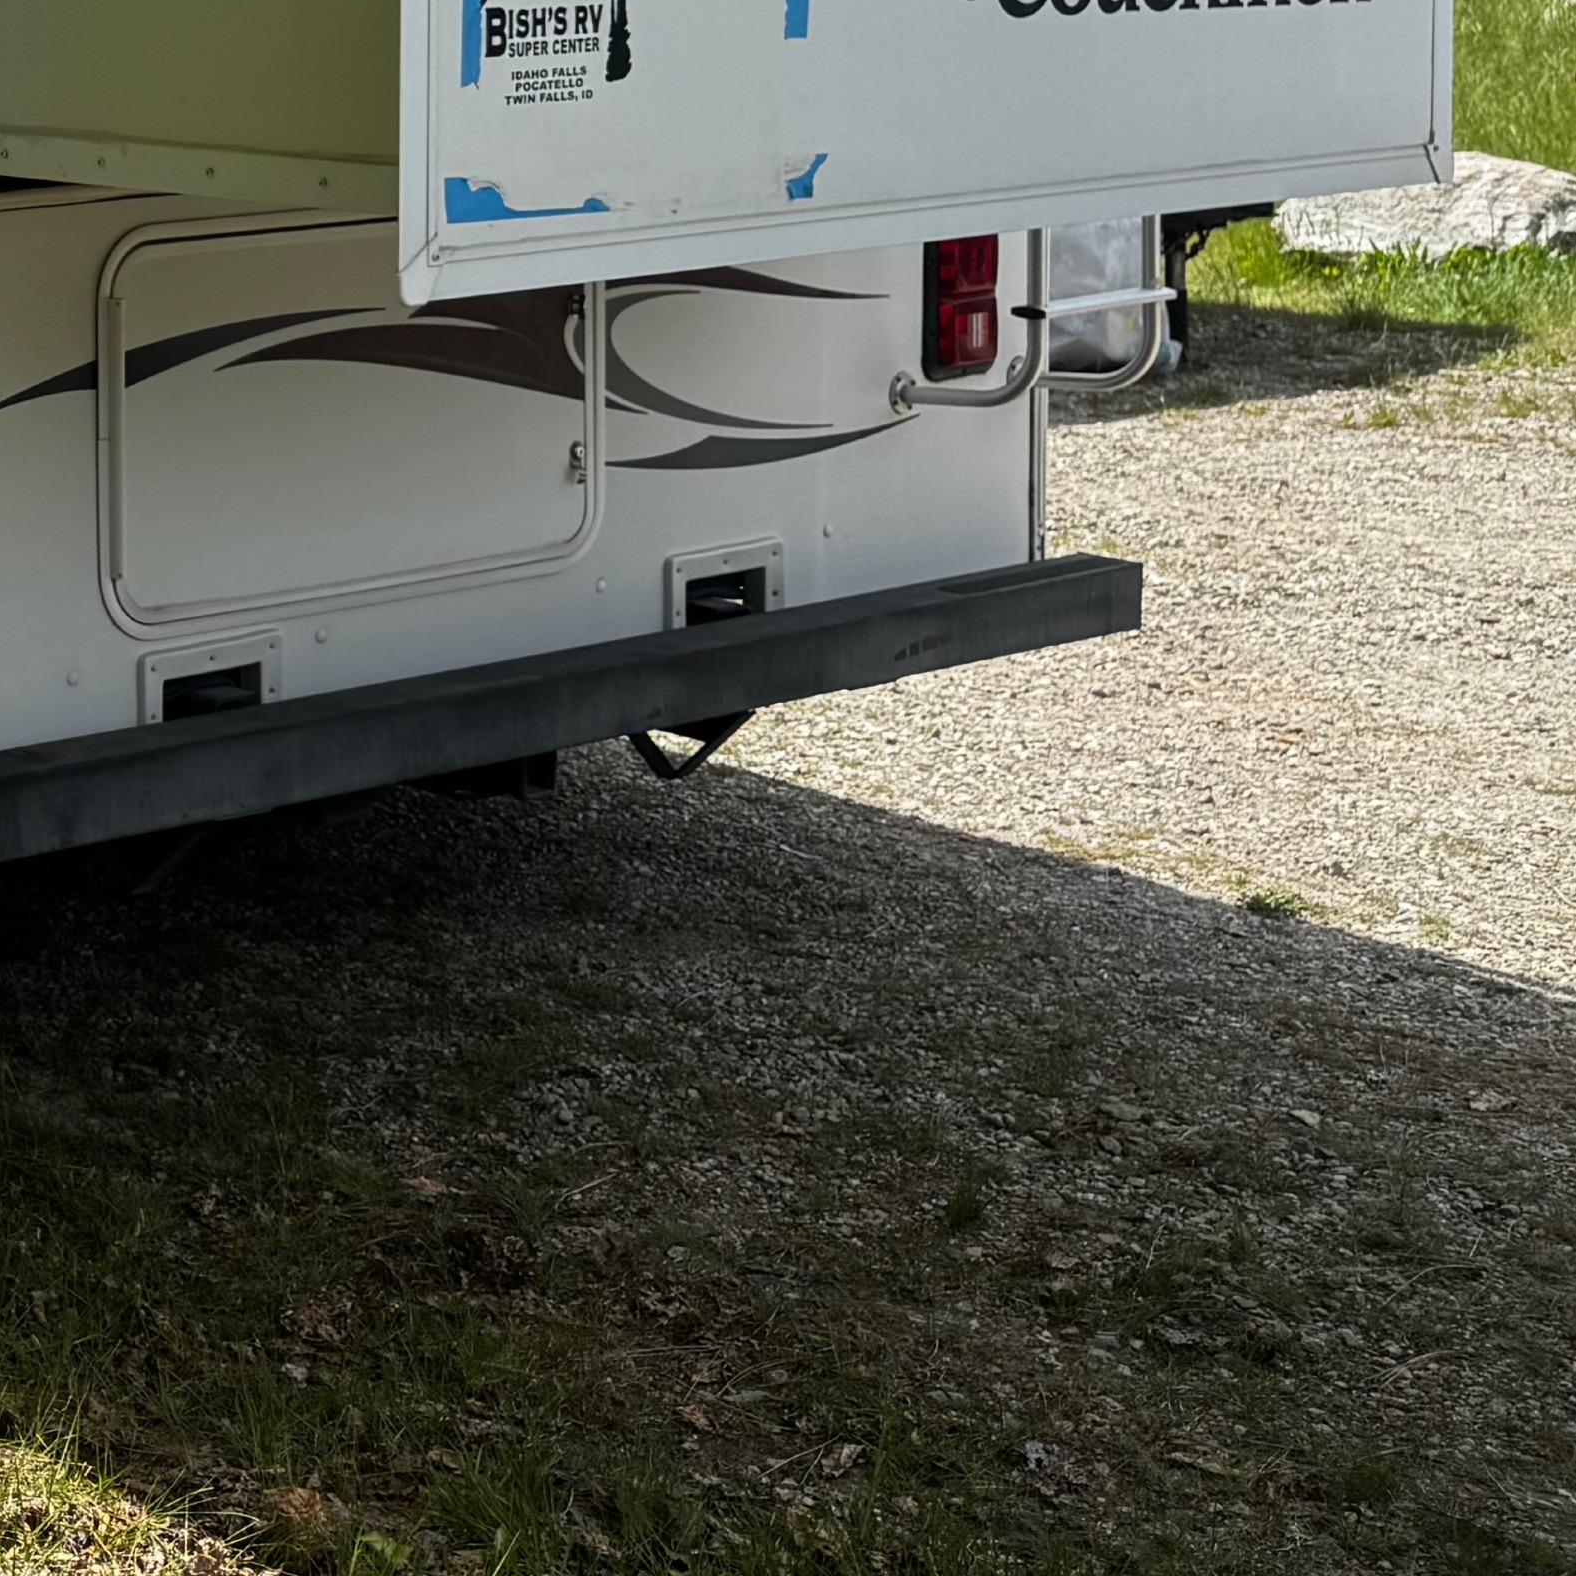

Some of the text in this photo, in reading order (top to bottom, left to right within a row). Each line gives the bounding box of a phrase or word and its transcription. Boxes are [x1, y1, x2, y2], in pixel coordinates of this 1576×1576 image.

[484, 4, 603, 58] BISH'S RV
[508, 37, 600, 58] SUPER CENTER
[511, 65, 587, 81] IDAHO FALLS
[515, 78, 584, 92] POCATELLO
[504, 89, 593, 106] TWIN FALLS, ID
